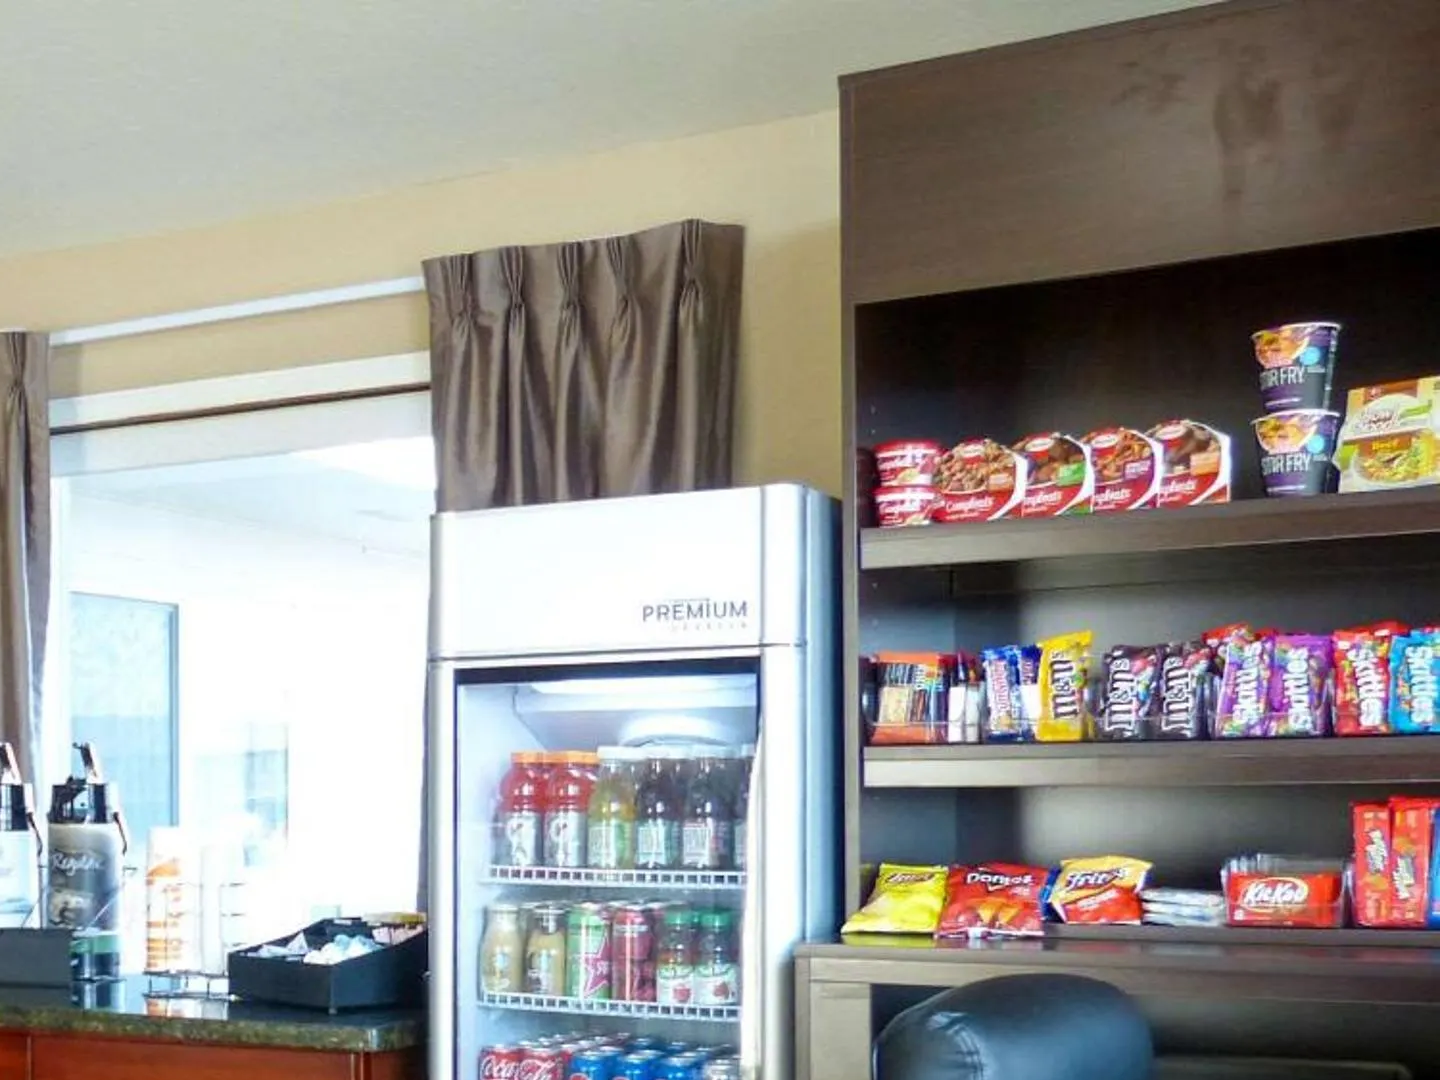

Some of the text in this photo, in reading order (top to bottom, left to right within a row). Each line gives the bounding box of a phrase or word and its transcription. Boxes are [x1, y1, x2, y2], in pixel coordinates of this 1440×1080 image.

[1280, 366, 1305, 385] FRY
[1285, 453, 1310, 472] FRY
[642, 599, 747, 622] PREMIUM
